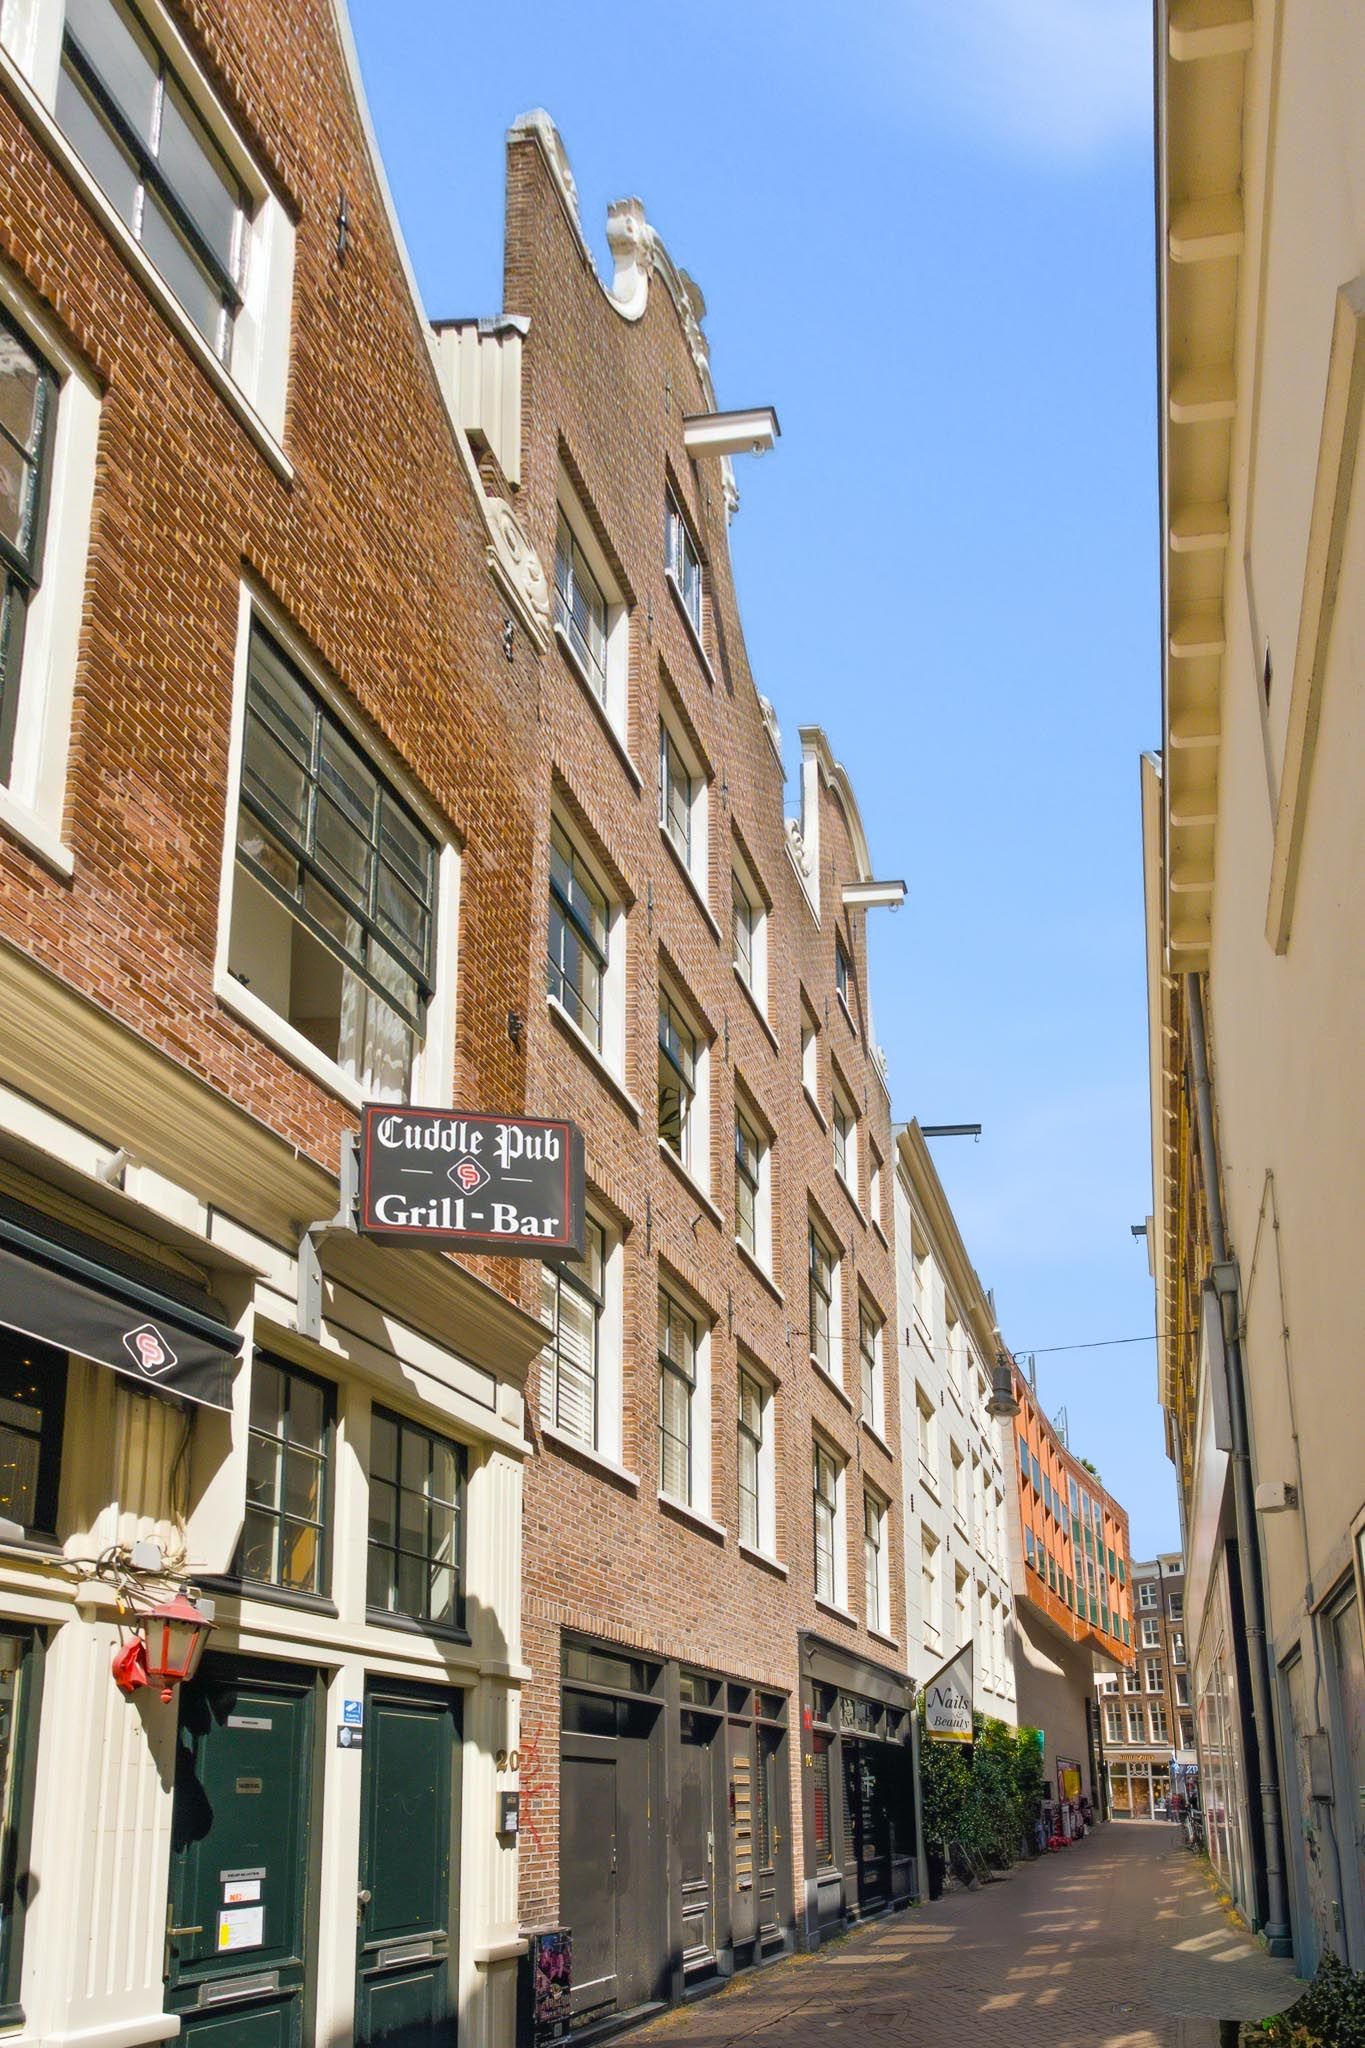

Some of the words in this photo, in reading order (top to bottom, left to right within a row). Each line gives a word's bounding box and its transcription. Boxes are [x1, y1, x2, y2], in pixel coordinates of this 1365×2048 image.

[376, 1115, 484, 1155] Cuddle
[493, 1124, 560, 1169] Pub
[928, 1687, 969, 1710] Nails
[934, 1716, 970, 1730] Beauty
[496, 1749, 519, 1773] 20
